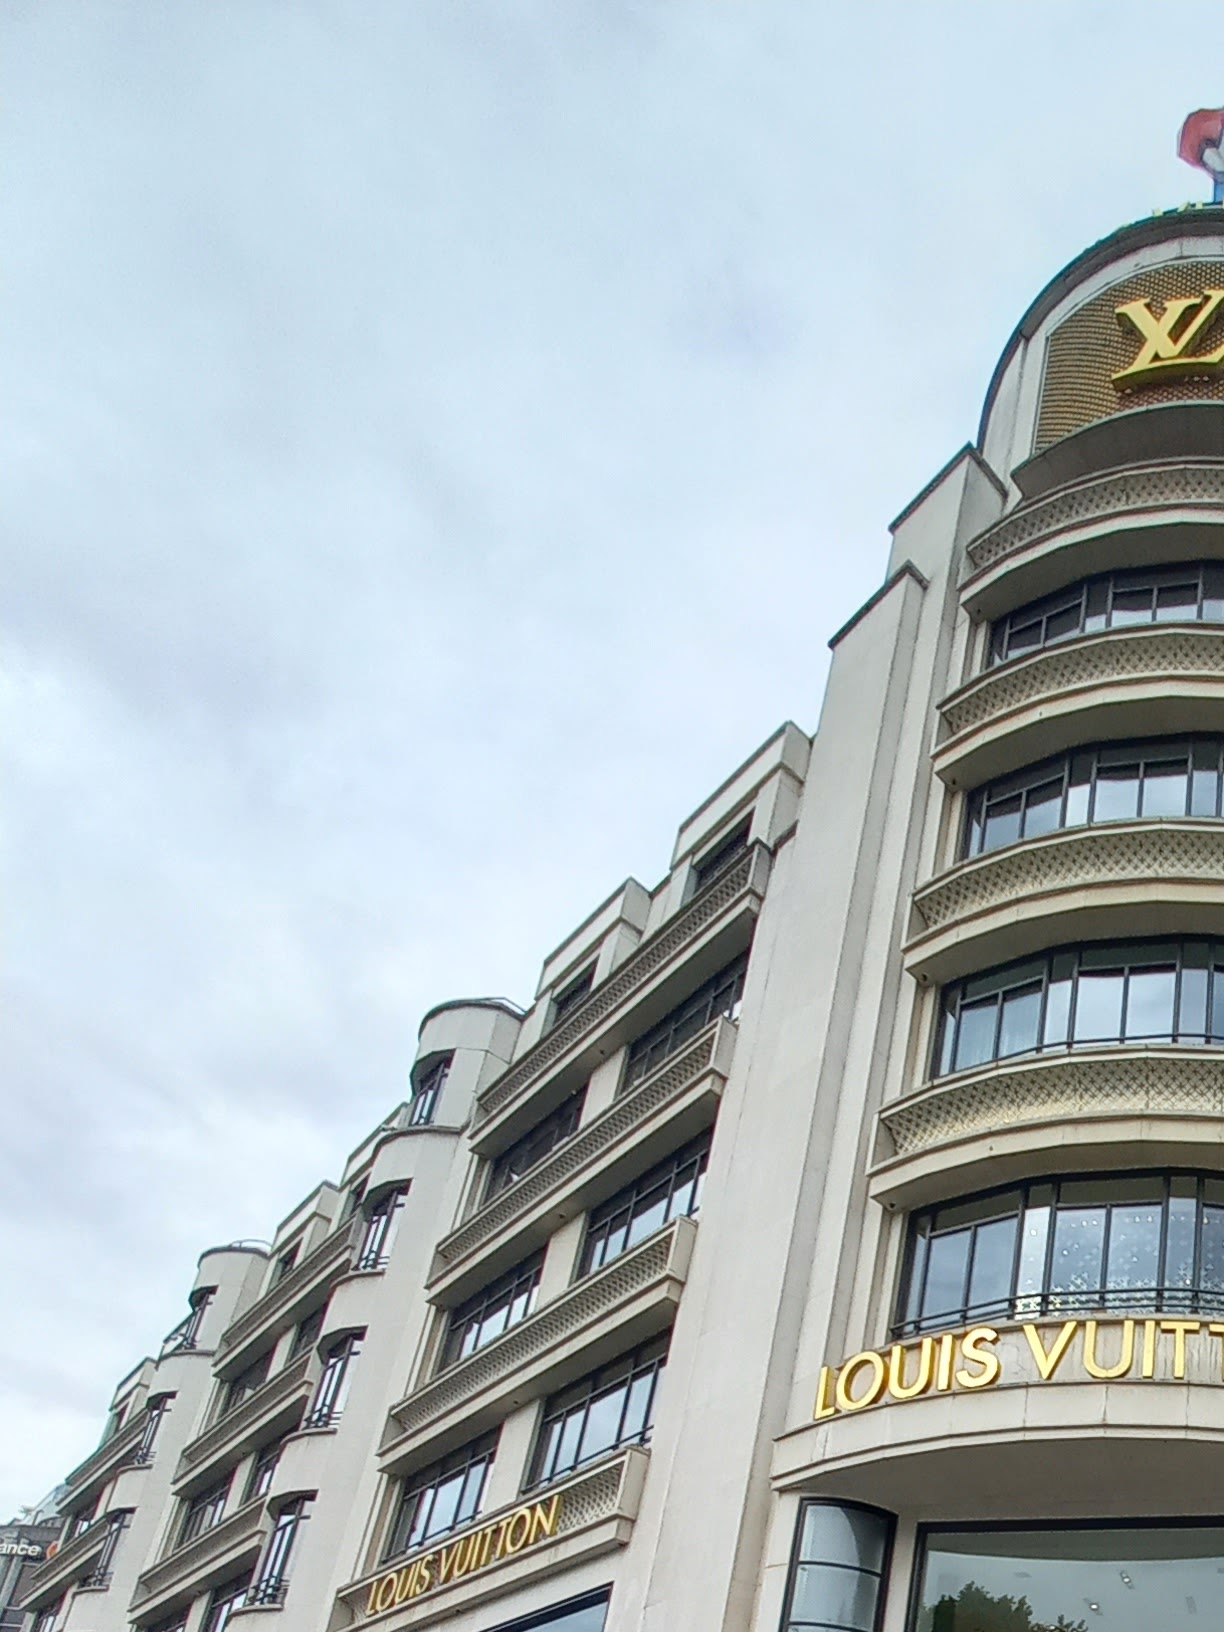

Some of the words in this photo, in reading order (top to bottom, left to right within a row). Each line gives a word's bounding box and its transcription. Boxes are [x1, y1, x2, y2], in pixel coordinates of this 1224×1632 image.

[813, 1326, 1001, 1421] LOUIS
[364, 1553, 434, 1618] LOUIS
[438, 1494, 563, 1585] VUITTON
